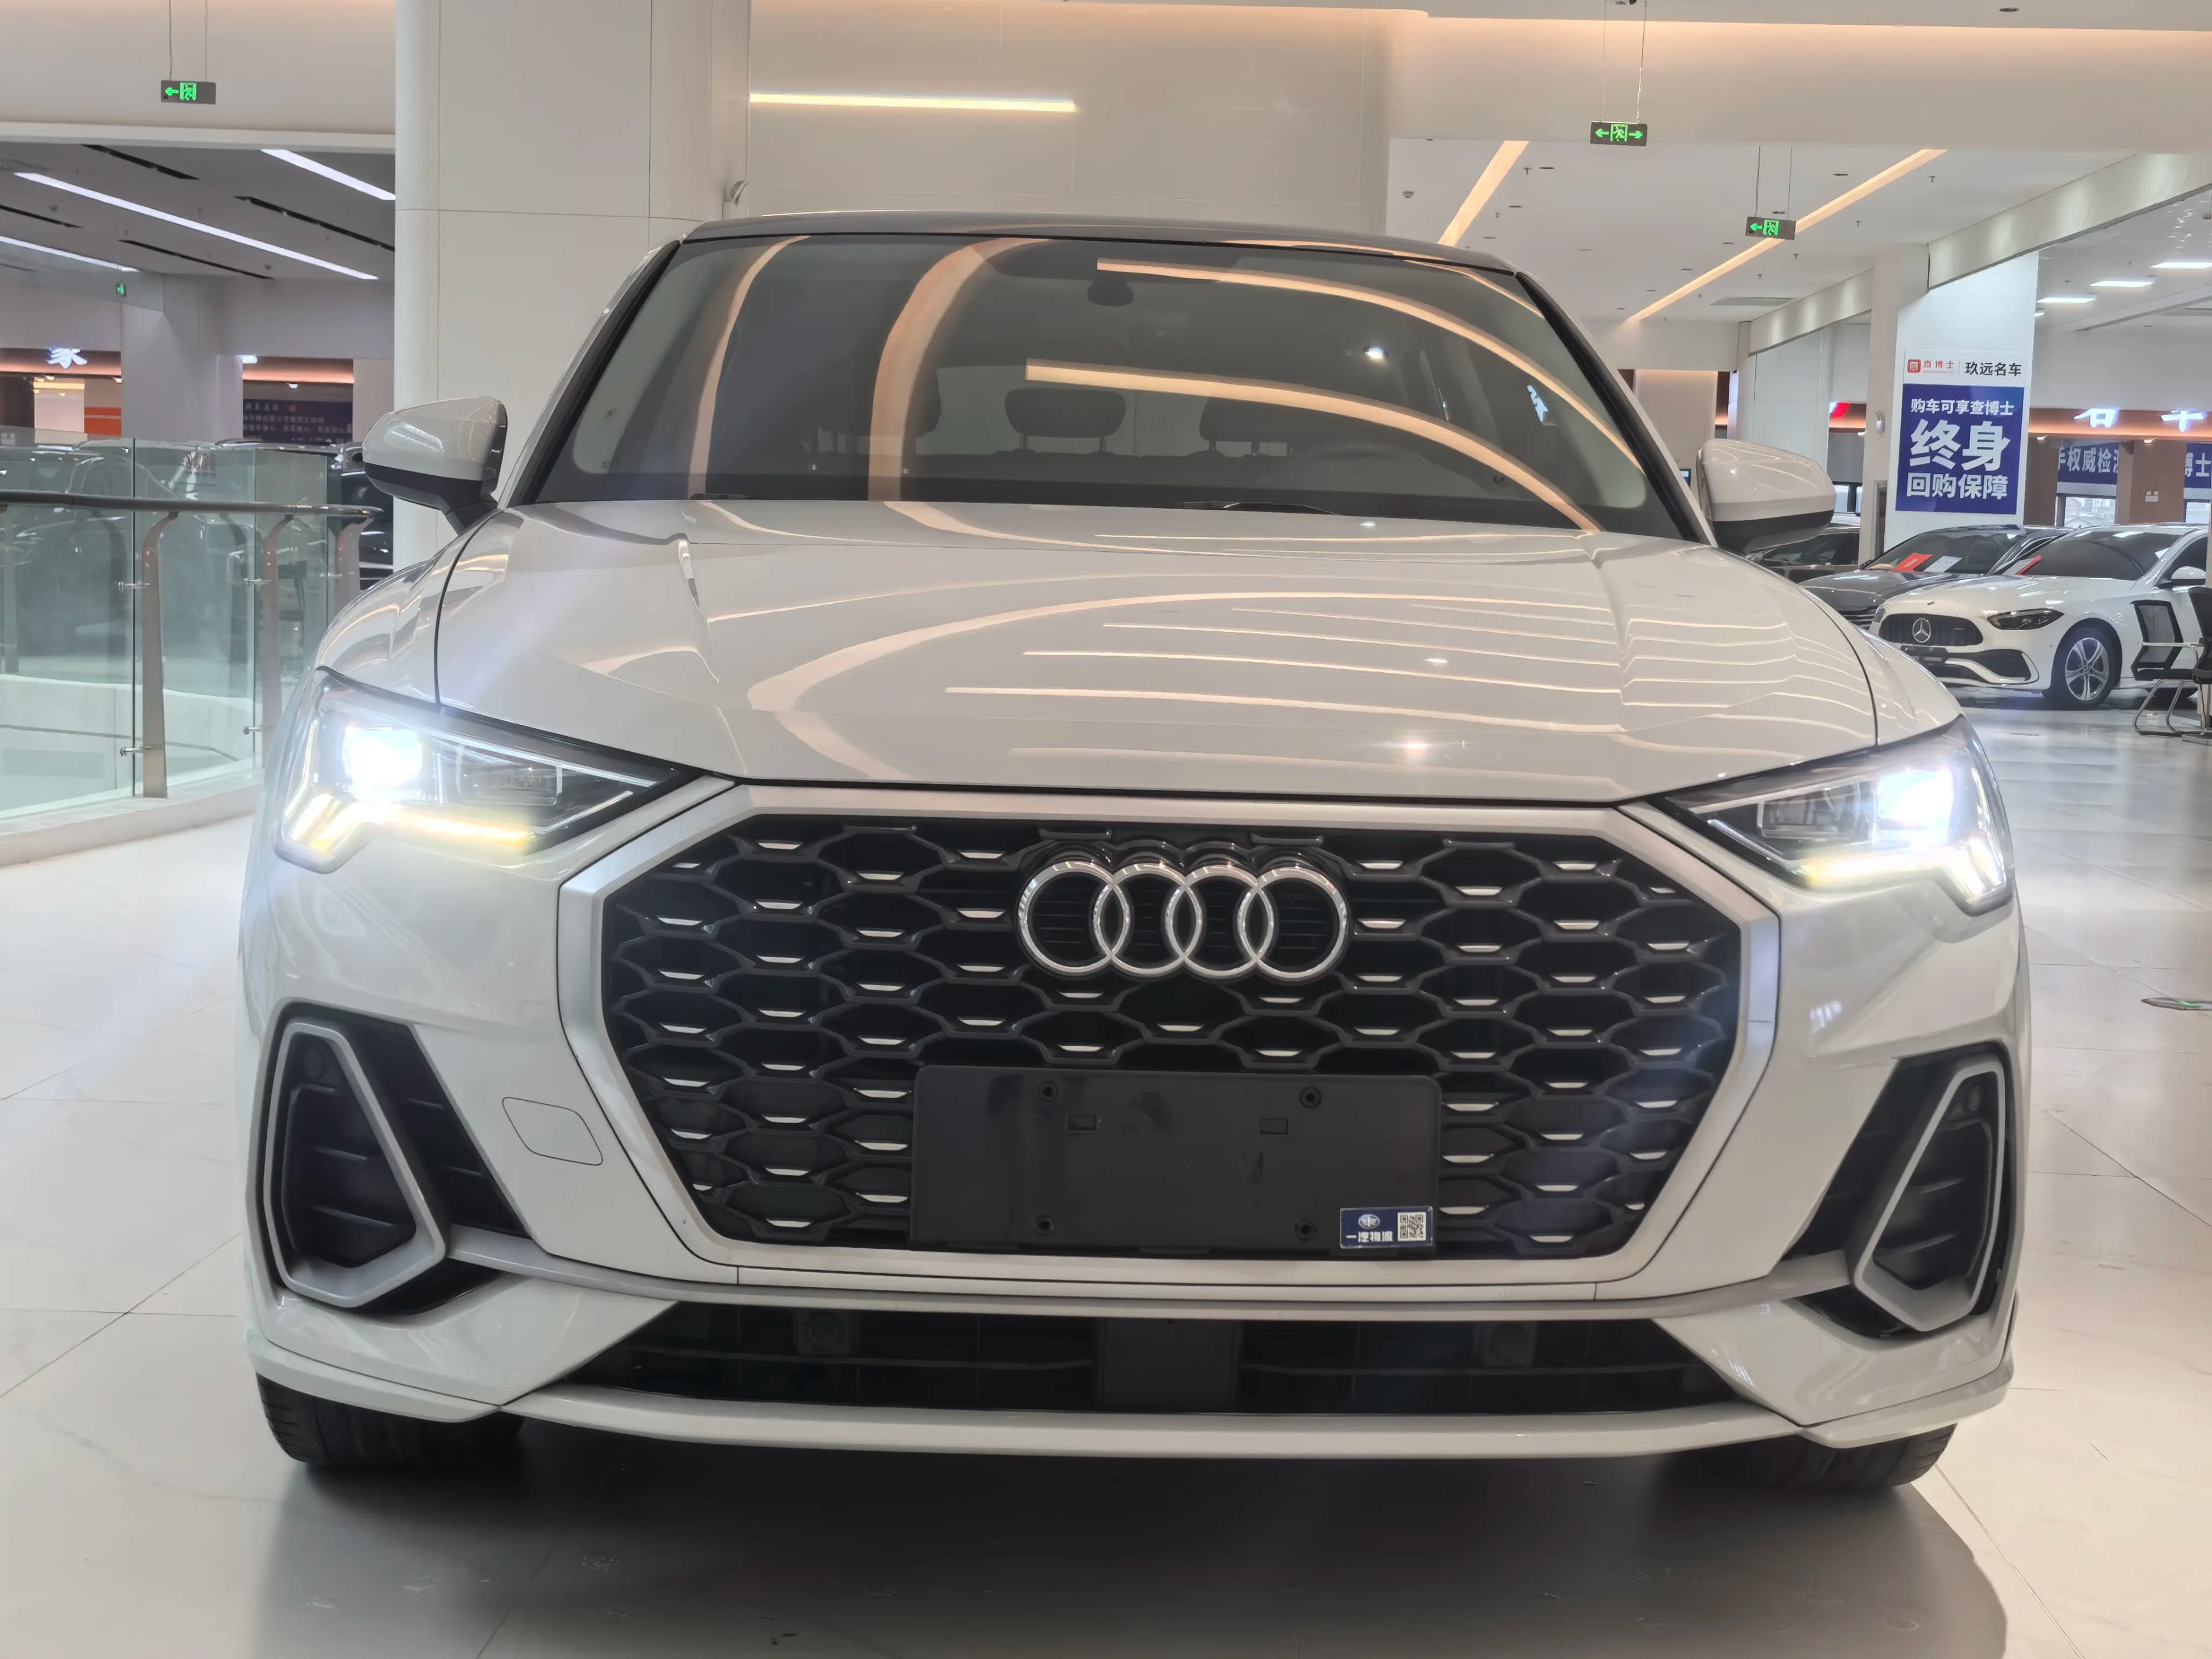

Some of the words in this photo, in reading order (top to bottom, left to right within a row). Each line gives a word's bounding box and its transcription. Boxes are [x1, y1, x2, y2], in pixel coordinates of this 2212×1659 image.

[1964, 362, 2022, 377] 玖远名车
[1910, 398, 2015, 416] 购车可享查博士
[1909, 419, 2012, 471] 终身
[1906, 472, 2009, 500] 回购保障
